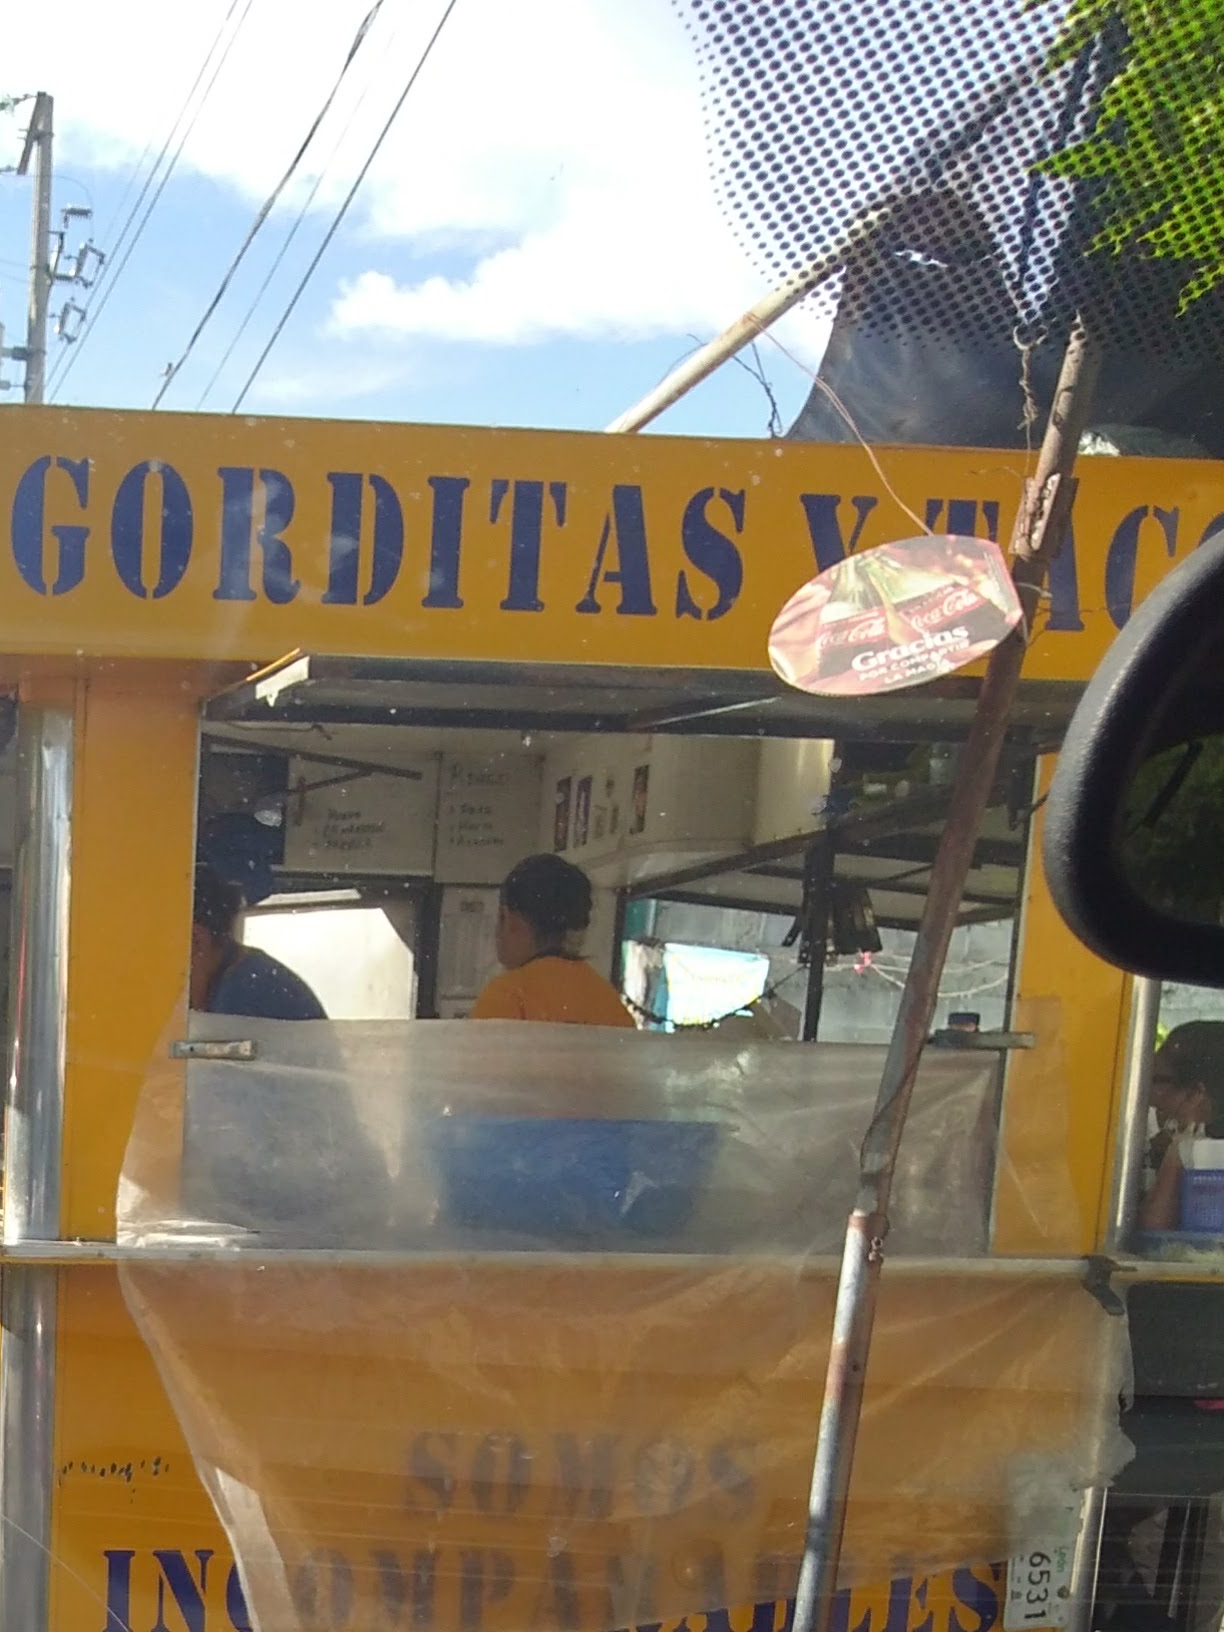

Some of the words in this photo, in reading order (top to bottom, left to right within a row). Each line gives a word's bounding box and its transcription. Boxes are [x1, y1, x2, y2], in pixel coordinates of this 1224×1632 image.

[11, 455, 747, 620] GORDITAS
[851, 625, 969, 671] Gracias
[859, 666, 888, 681] POR
[404, 1431, 760, 1524] SOMOS
[1018, 1550, 1052, 1620] 6531
